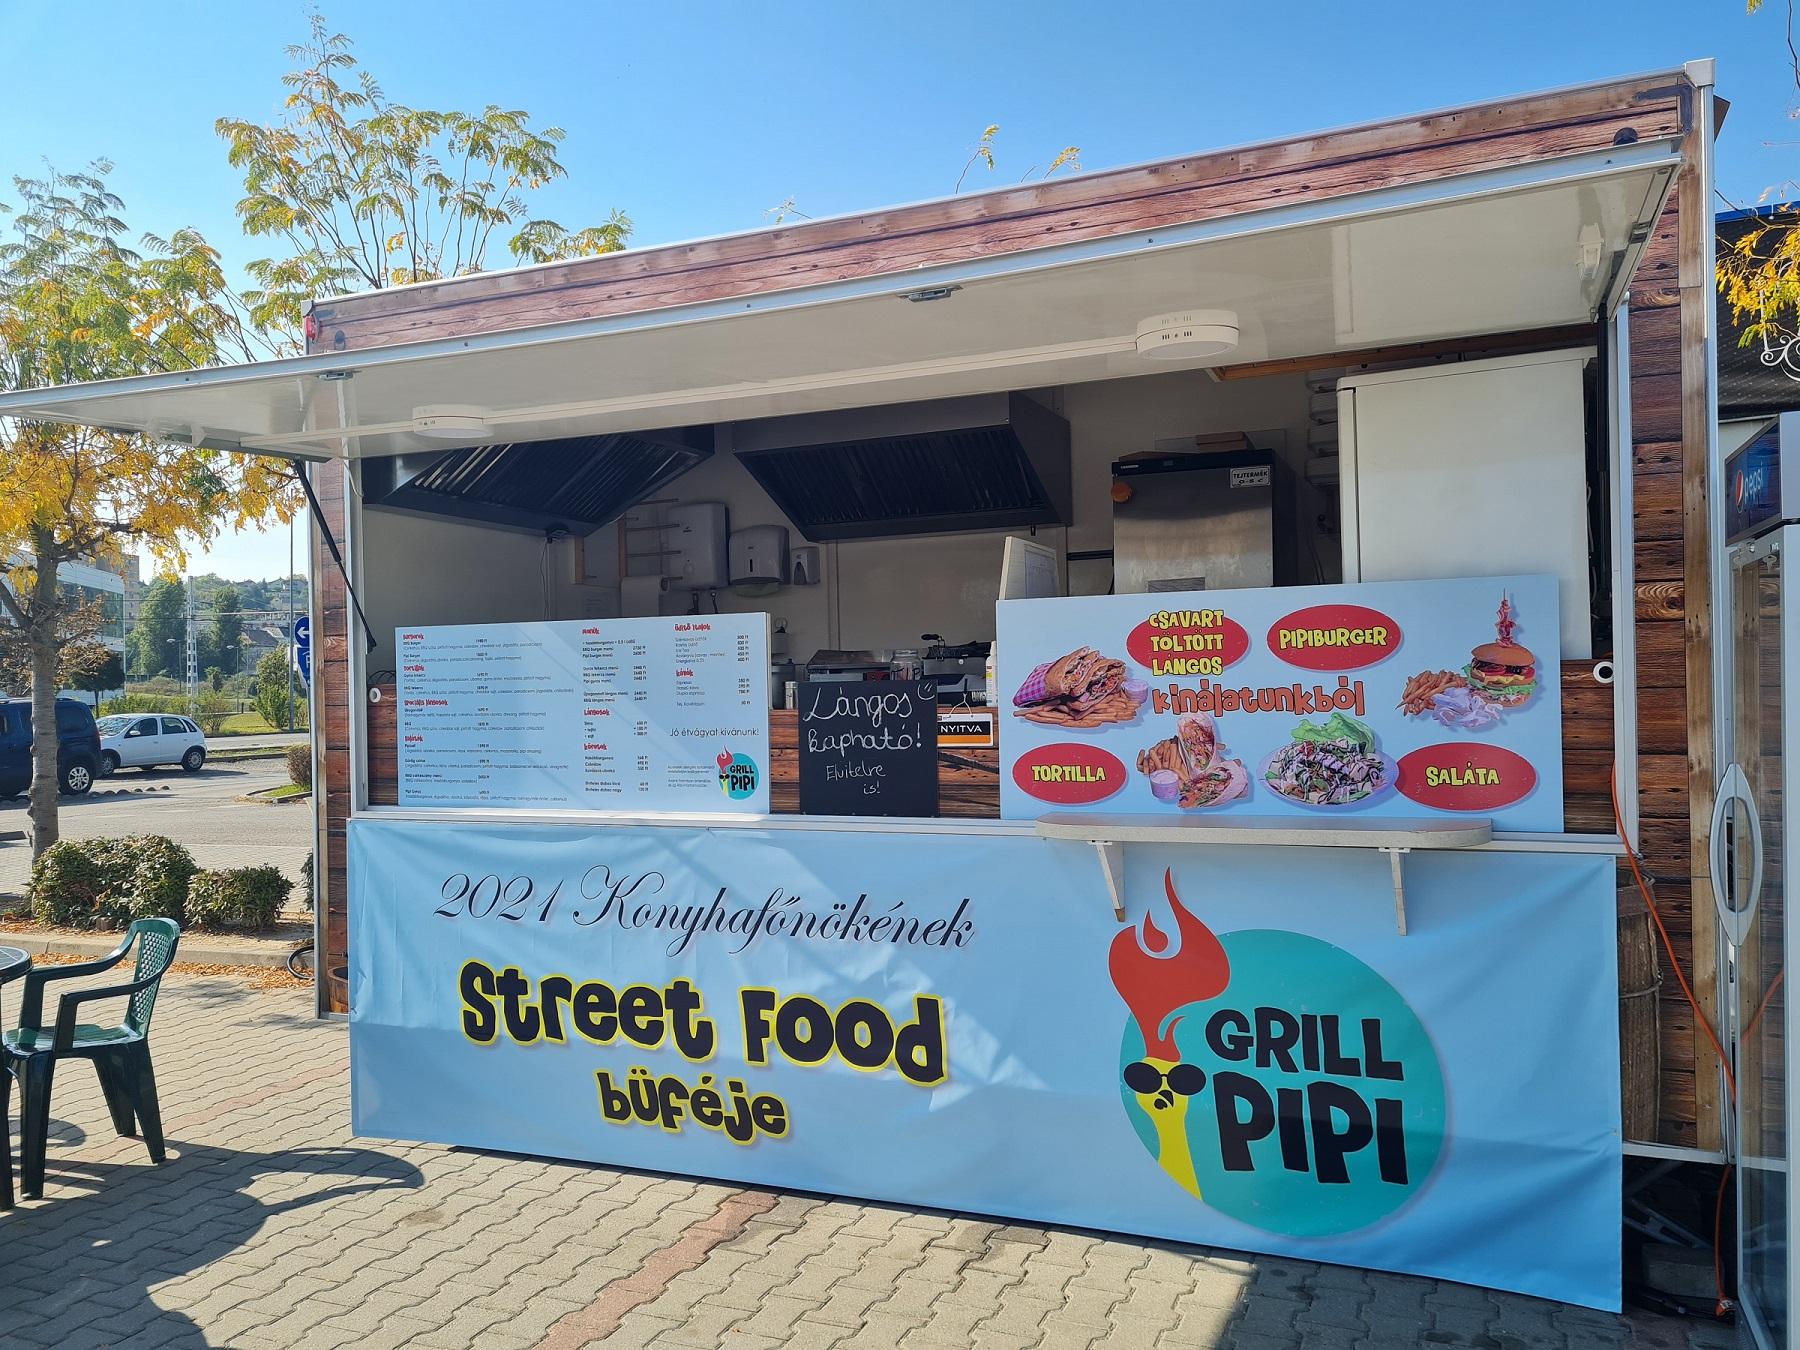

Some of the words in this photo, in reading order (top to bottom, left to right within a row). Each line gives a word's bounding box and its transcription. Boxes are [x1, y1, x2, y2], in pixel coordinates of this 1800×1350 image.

[1744, 462, 1763, 504] pepsi
[1149, 609, 1224, 630] CSAVART
[1150, 629, 1224, 652] TÖLTÖTT
[1279, 626, 1388, 649] PIPIBURGER
[1152, 654, 1223, 676] LÁNGOS
[803, 686, 913, 728] Lángos
[670, 728, 680, 737] Jó
[681, 727, 718, 739] étvágyat
[940, 724, 983, 733] NYITVA
[729, 764, 755, 774] GRILL
[1031, 764, 1106, 782] TORTILLA
[1425, 761, 1500, 787] SALÁTA
[730, 774, 755, 791] PIPI
[863, 780, 881, 794] is!
[433, 872, 564, 921] 2021
[573, 864, 974, 957] Konyhafőnökének
[459, 958, 717, 1063] Street
[1205, 1006, 1405, 1082] GRILL
[595, 1066, 790, 1146] büféje
[1212, 1071, 1409, 1186] PIPI
